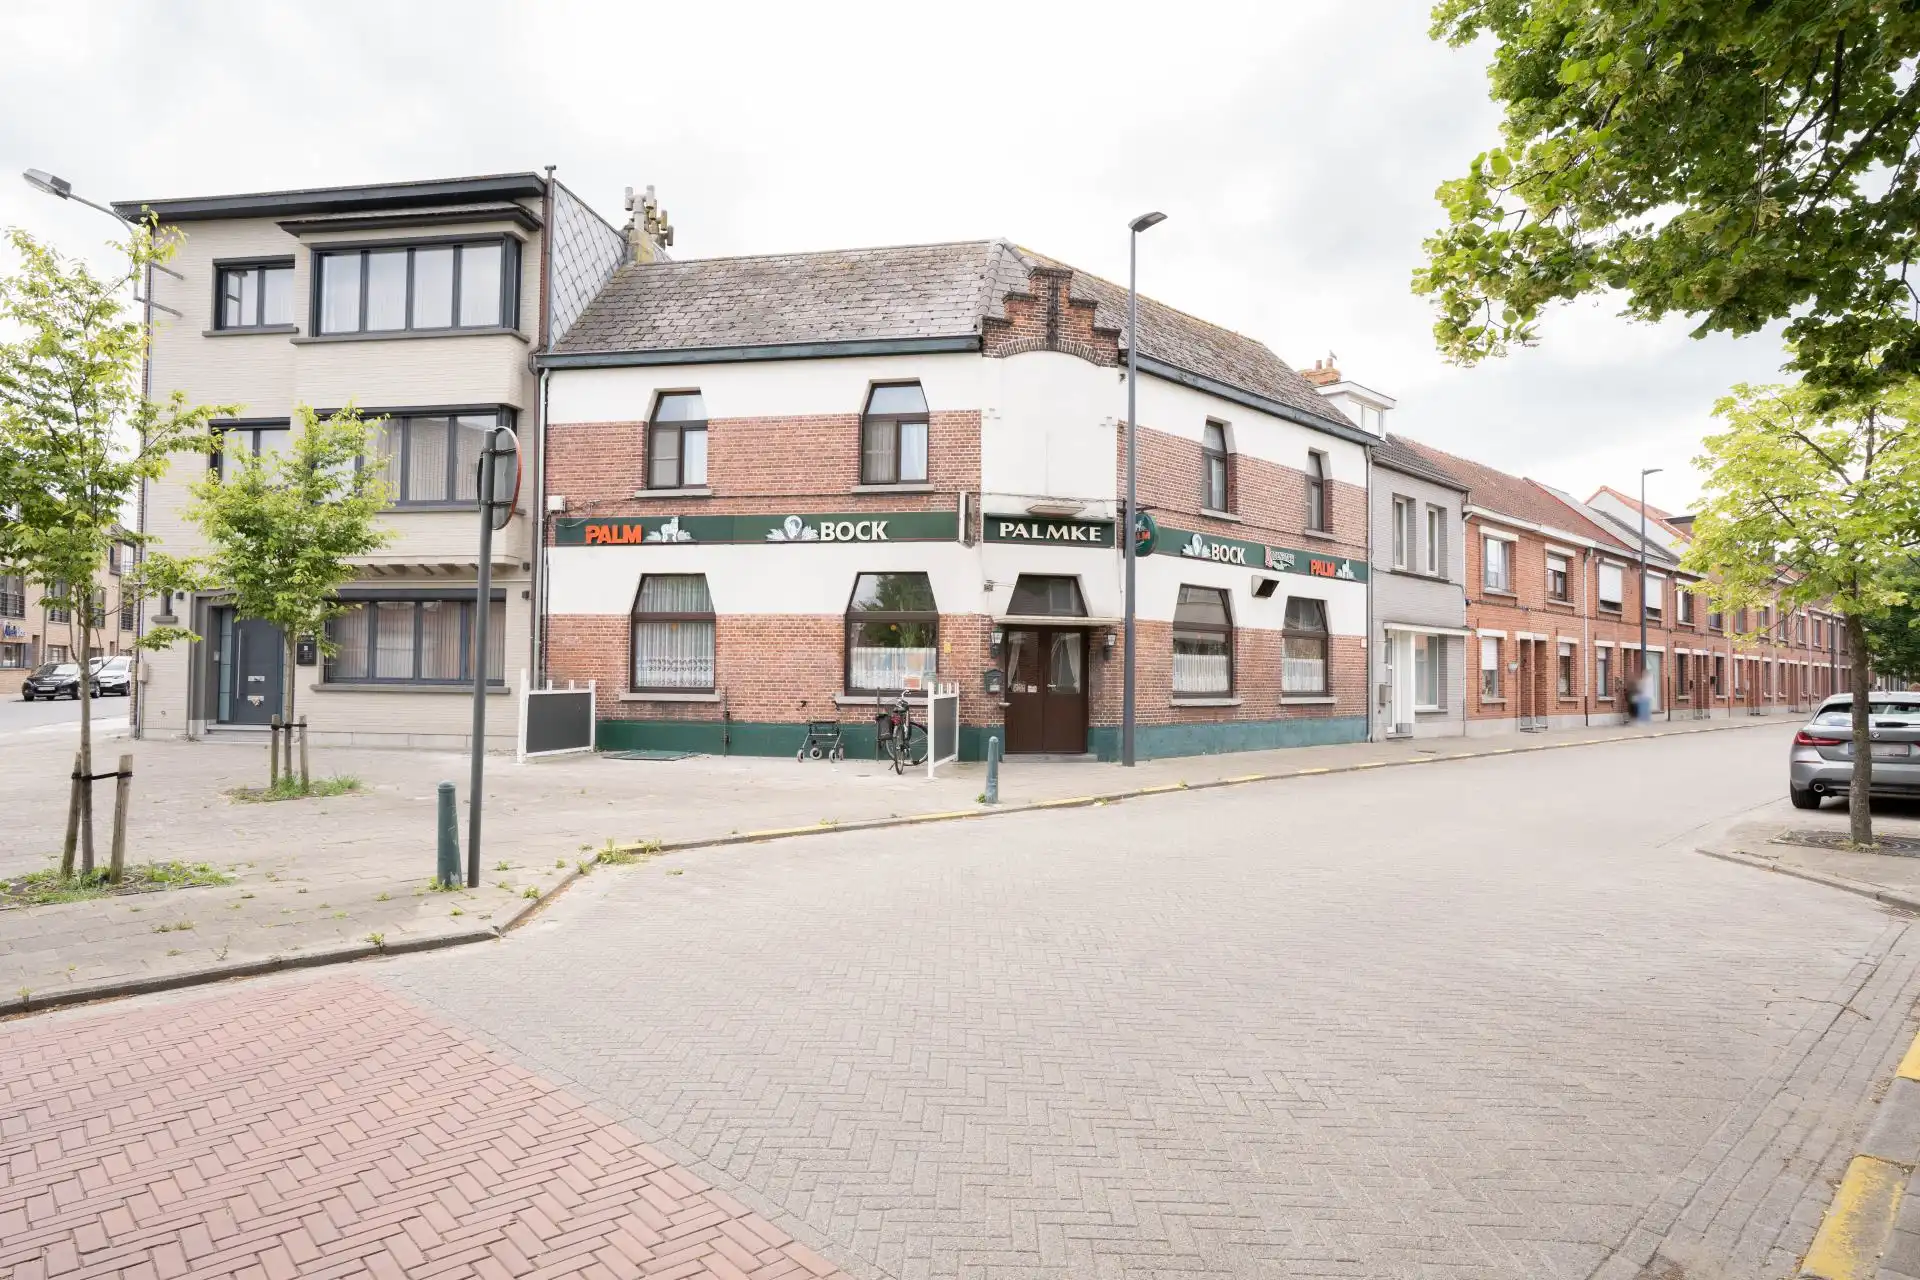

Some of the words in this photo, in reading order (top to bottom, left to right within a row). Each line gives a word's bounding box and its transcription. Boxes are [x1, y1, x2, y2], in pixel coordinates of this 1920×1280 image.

[585, 524, 642, 544] PALM
[820, 521, 889, 541] BOCK
[1000, 522, 1101, 541] PALMKE
[1211, 543, 1246, 565] BOCK
[1310, 559, 1336, 577] PALM
